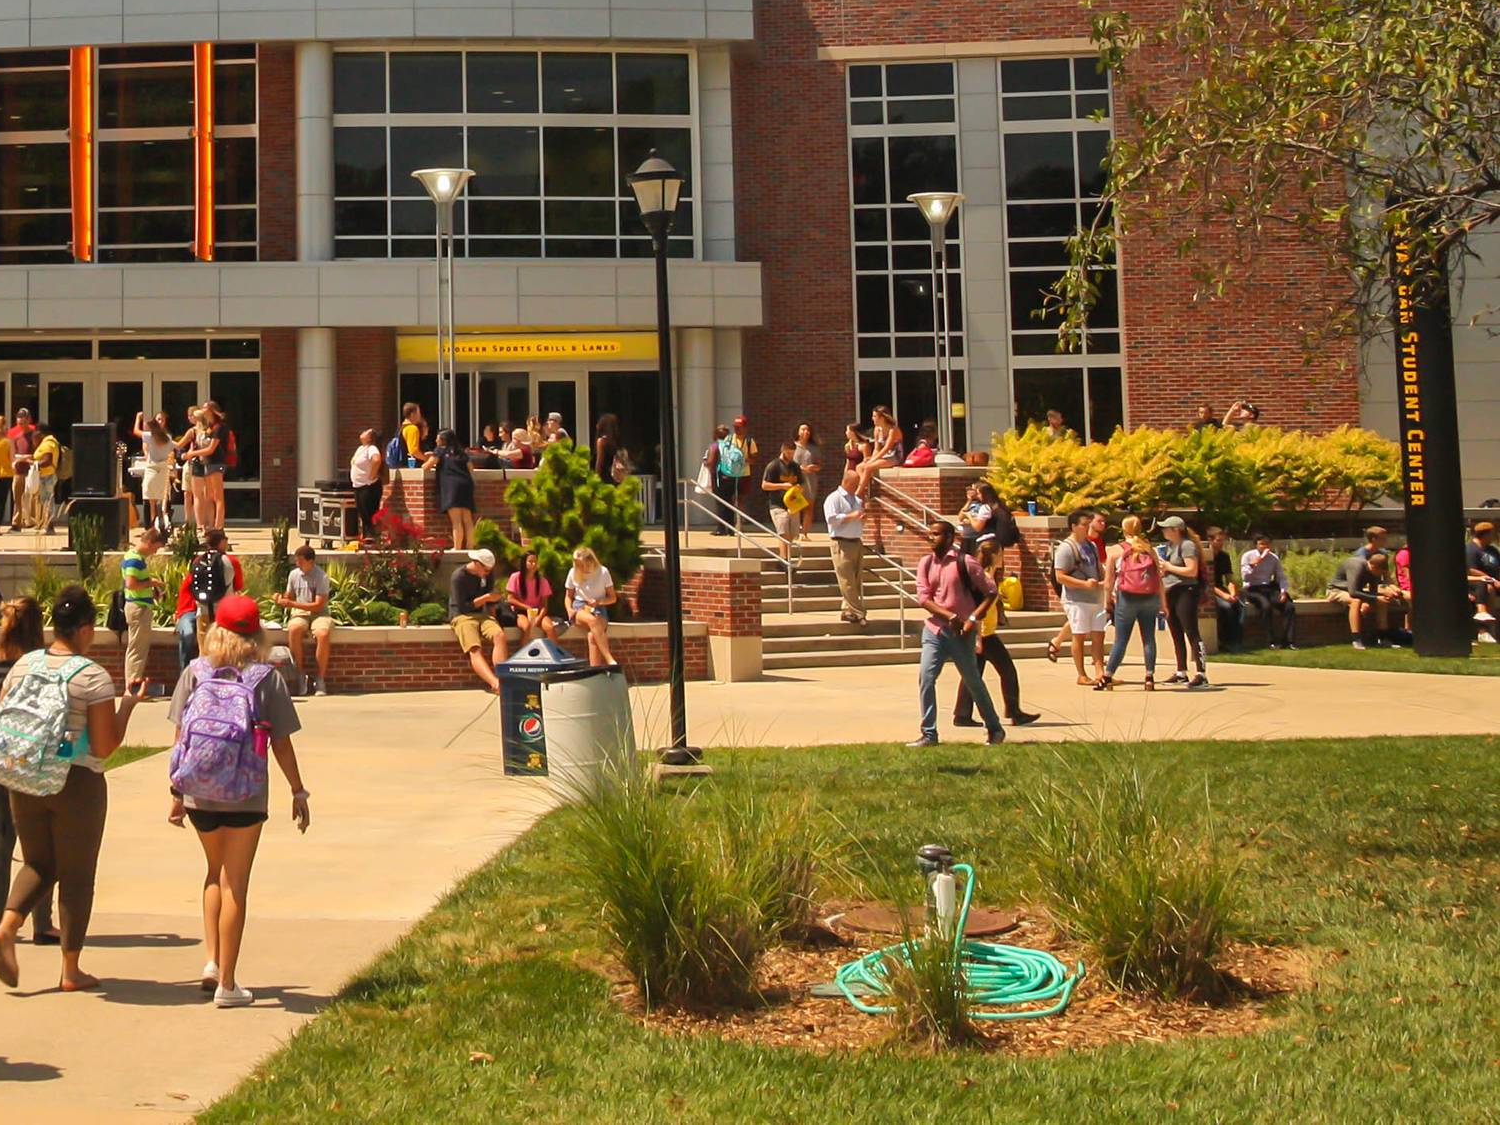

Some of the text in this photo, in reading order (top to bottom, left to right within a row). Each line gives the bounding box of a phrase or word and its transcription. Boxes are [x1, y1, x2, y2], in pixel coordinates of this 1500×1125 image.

[492, 344, 531, 353] SPORTS
[536, 344, 566, 353] GRILL
[582, 343, 615, 352] LANES
[1395, 223, 1426, 506] ATGAN STUDENT CENTER
